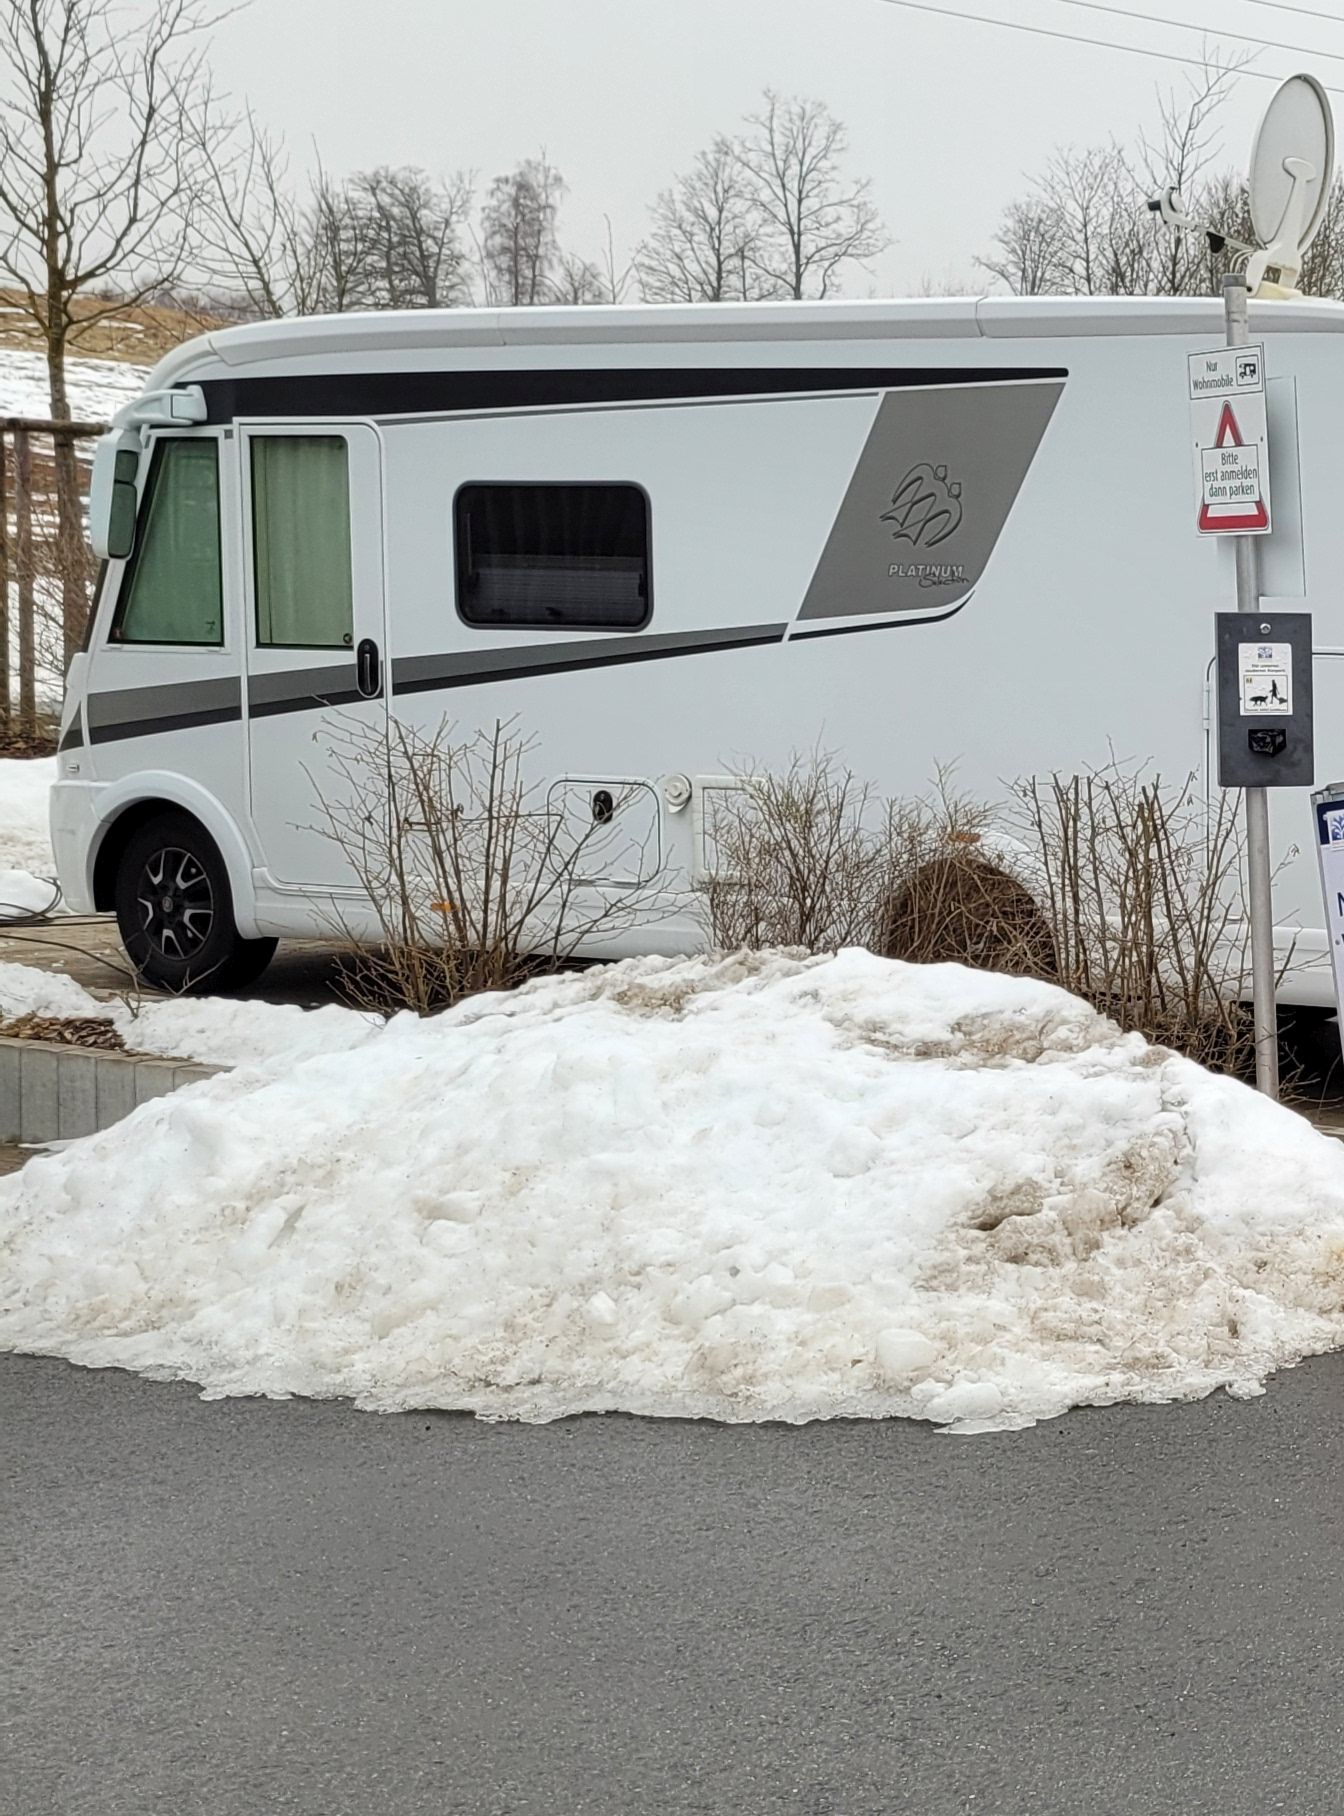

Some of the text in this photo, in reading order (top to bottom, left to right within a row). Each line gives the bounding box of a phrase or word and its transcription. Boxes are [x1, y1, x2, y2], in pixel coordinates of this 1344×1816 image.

[1206, 360, 1218, 372] Nur
[1192, 374, 1234, 391] Wohnmobile
[1221, 451, 1239, 466] Bitte
[1204, 465, 1258, 482] erst anmelden
[1208, 481, 1255, 500] dann parken
[889, 564, 963, 577] PLATINUM
